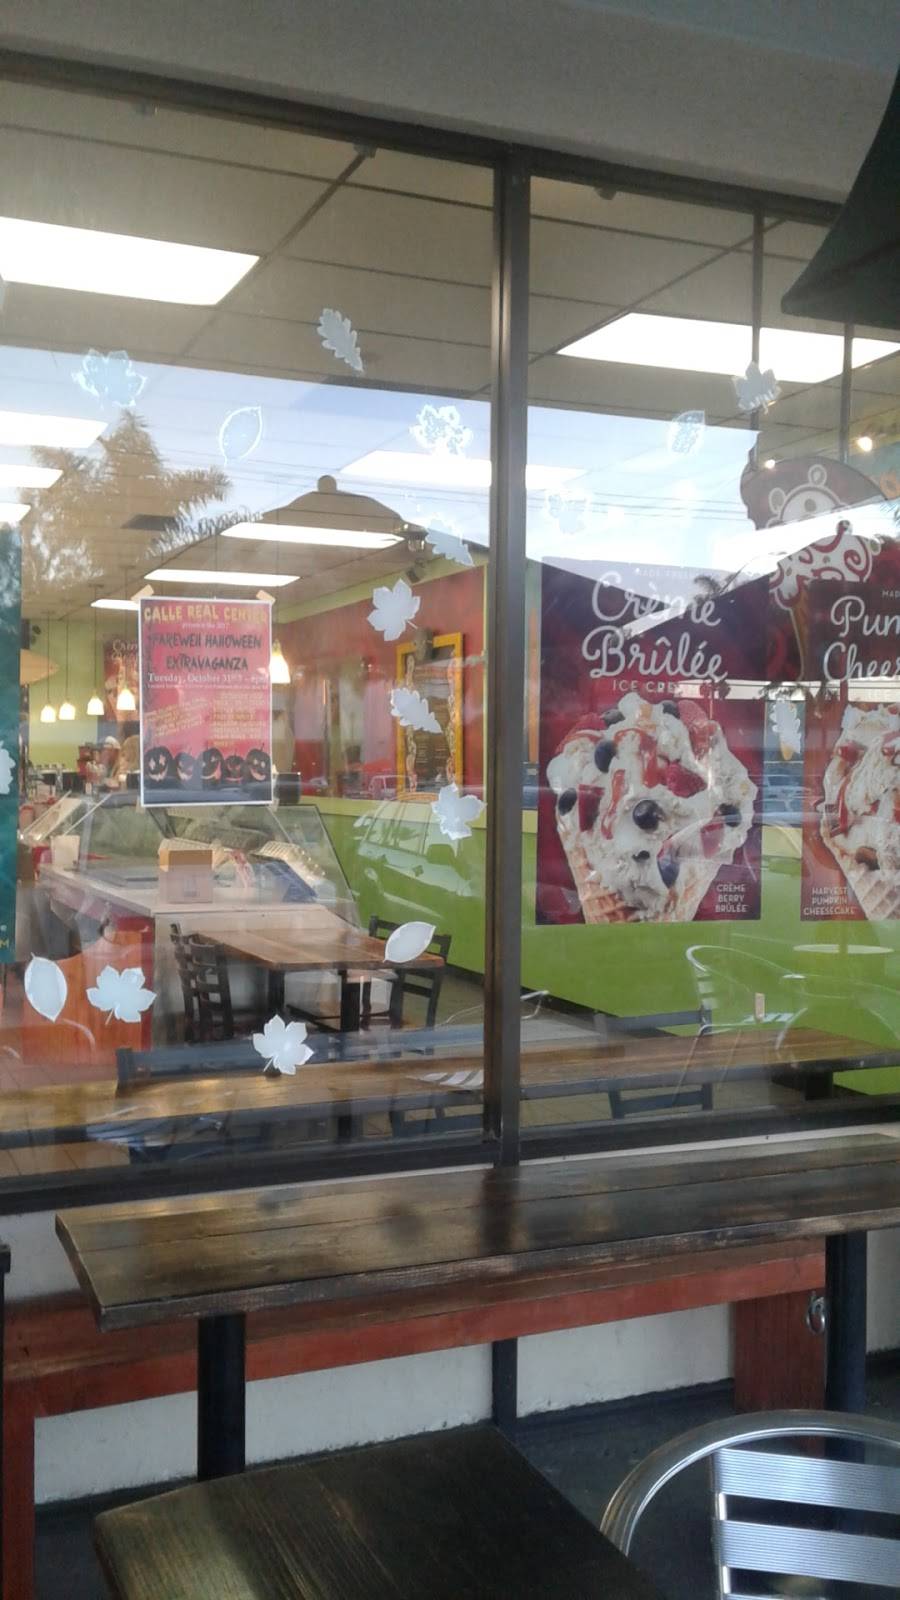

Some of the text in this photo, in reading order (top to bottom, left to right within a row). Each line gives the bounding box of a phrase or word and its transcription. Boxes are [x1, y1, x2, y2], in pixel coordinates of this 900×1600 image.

[143, 606, 182, 621] CALLE
[187, 604, 219, 619] REAL
[582, 625, 728, 681] Brûlée
[165, 653, 248, 671] EXTRAVAGANZA
[613, 679, 640, 692] ICE
[812, 886, 847, 895] HARVEST
[718, 894, 745, 903] BERRY
[812, 896, 848, 905] PUMPKIN
[803, 906, 856, 916] CHEESECAKE
